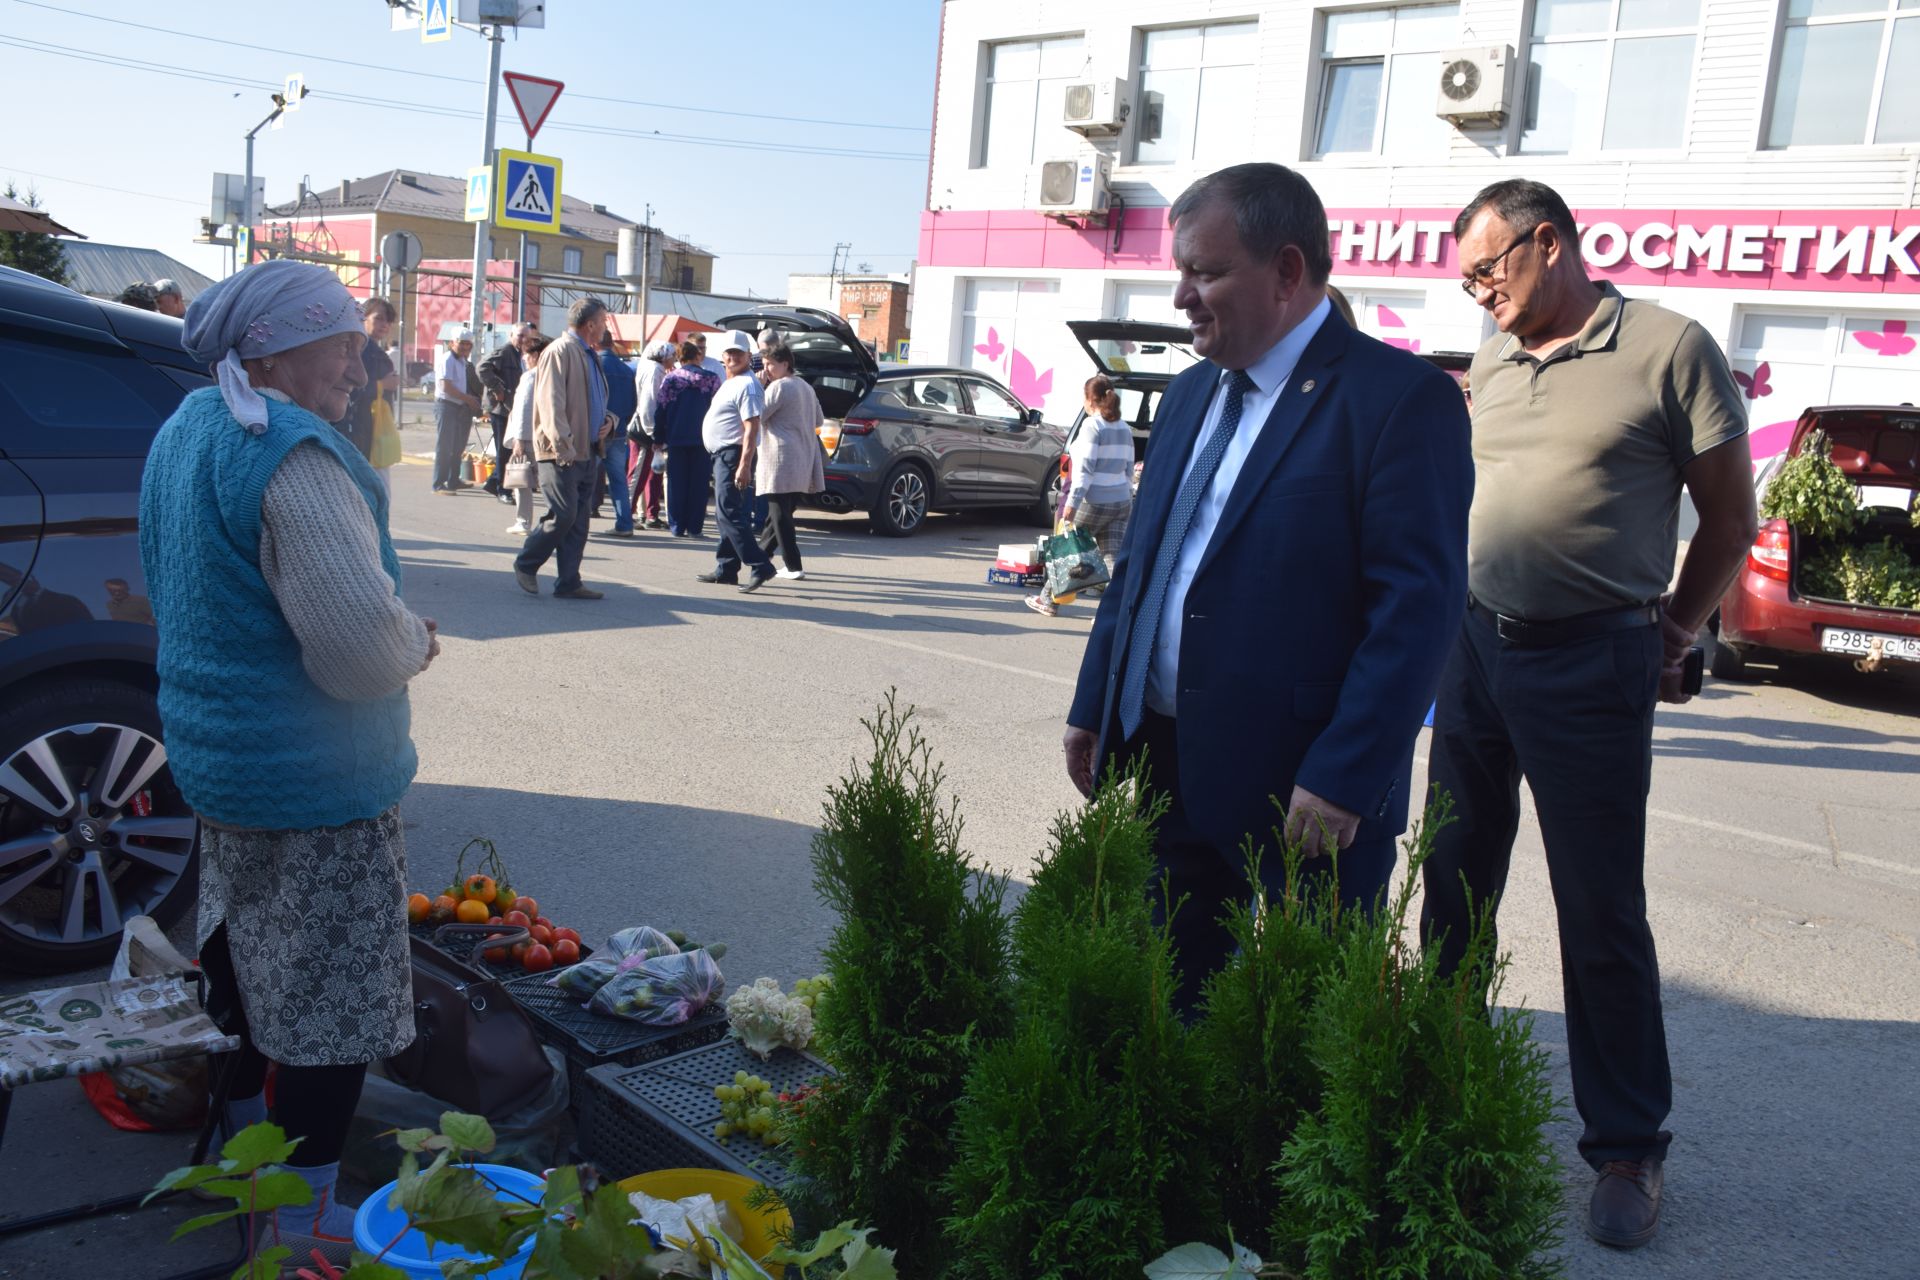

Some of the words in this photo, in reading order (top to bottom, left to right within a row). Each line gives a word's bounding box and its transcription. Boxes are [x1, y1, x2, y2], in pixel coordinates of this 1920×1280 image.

[1327, 219, 1454, 262] НИТ
[1575, 221, 1920, 275] ОСМЕТИК
[869, 291, 888, 303] МИР
